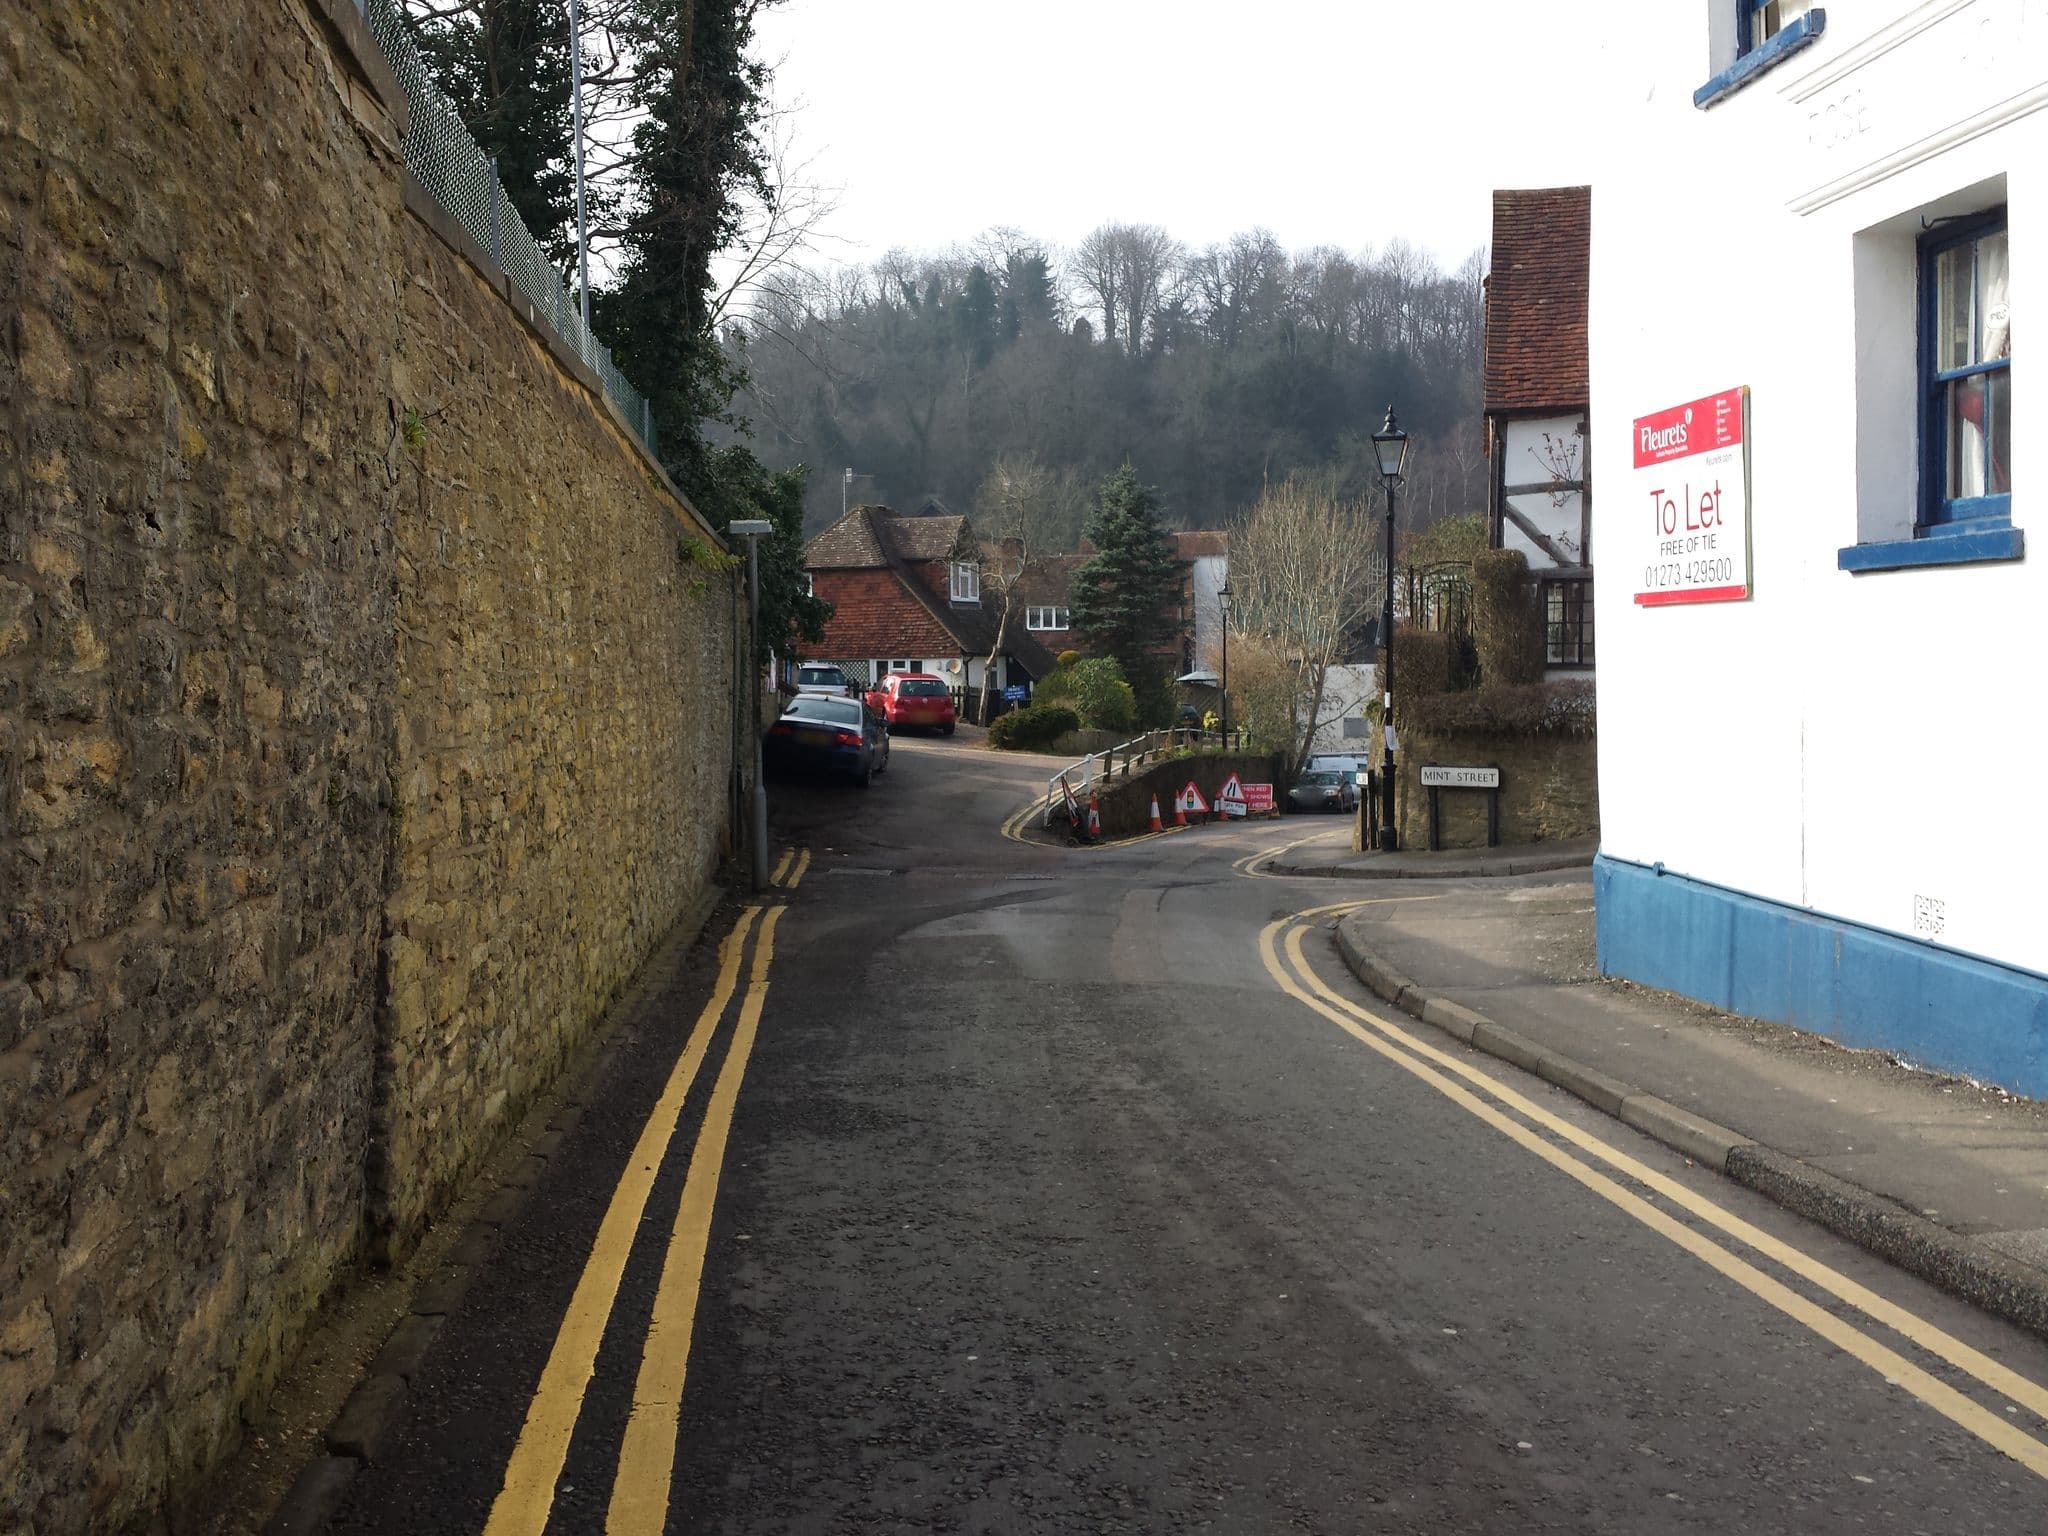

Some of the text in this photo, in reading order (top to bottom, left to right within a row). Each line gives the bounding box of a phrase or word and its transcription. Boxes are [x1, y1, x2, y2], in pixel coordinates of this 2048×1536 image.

[1641, 422, 1688, 453] Fleurets
[1650, 479, 1723, 536] To Let
[1660, 533, 1717, 557] FREE OF TIE
[1645, 557, 1732, 587] 01273 429500
[1424, 771, 1496, 782] MINT STREET
